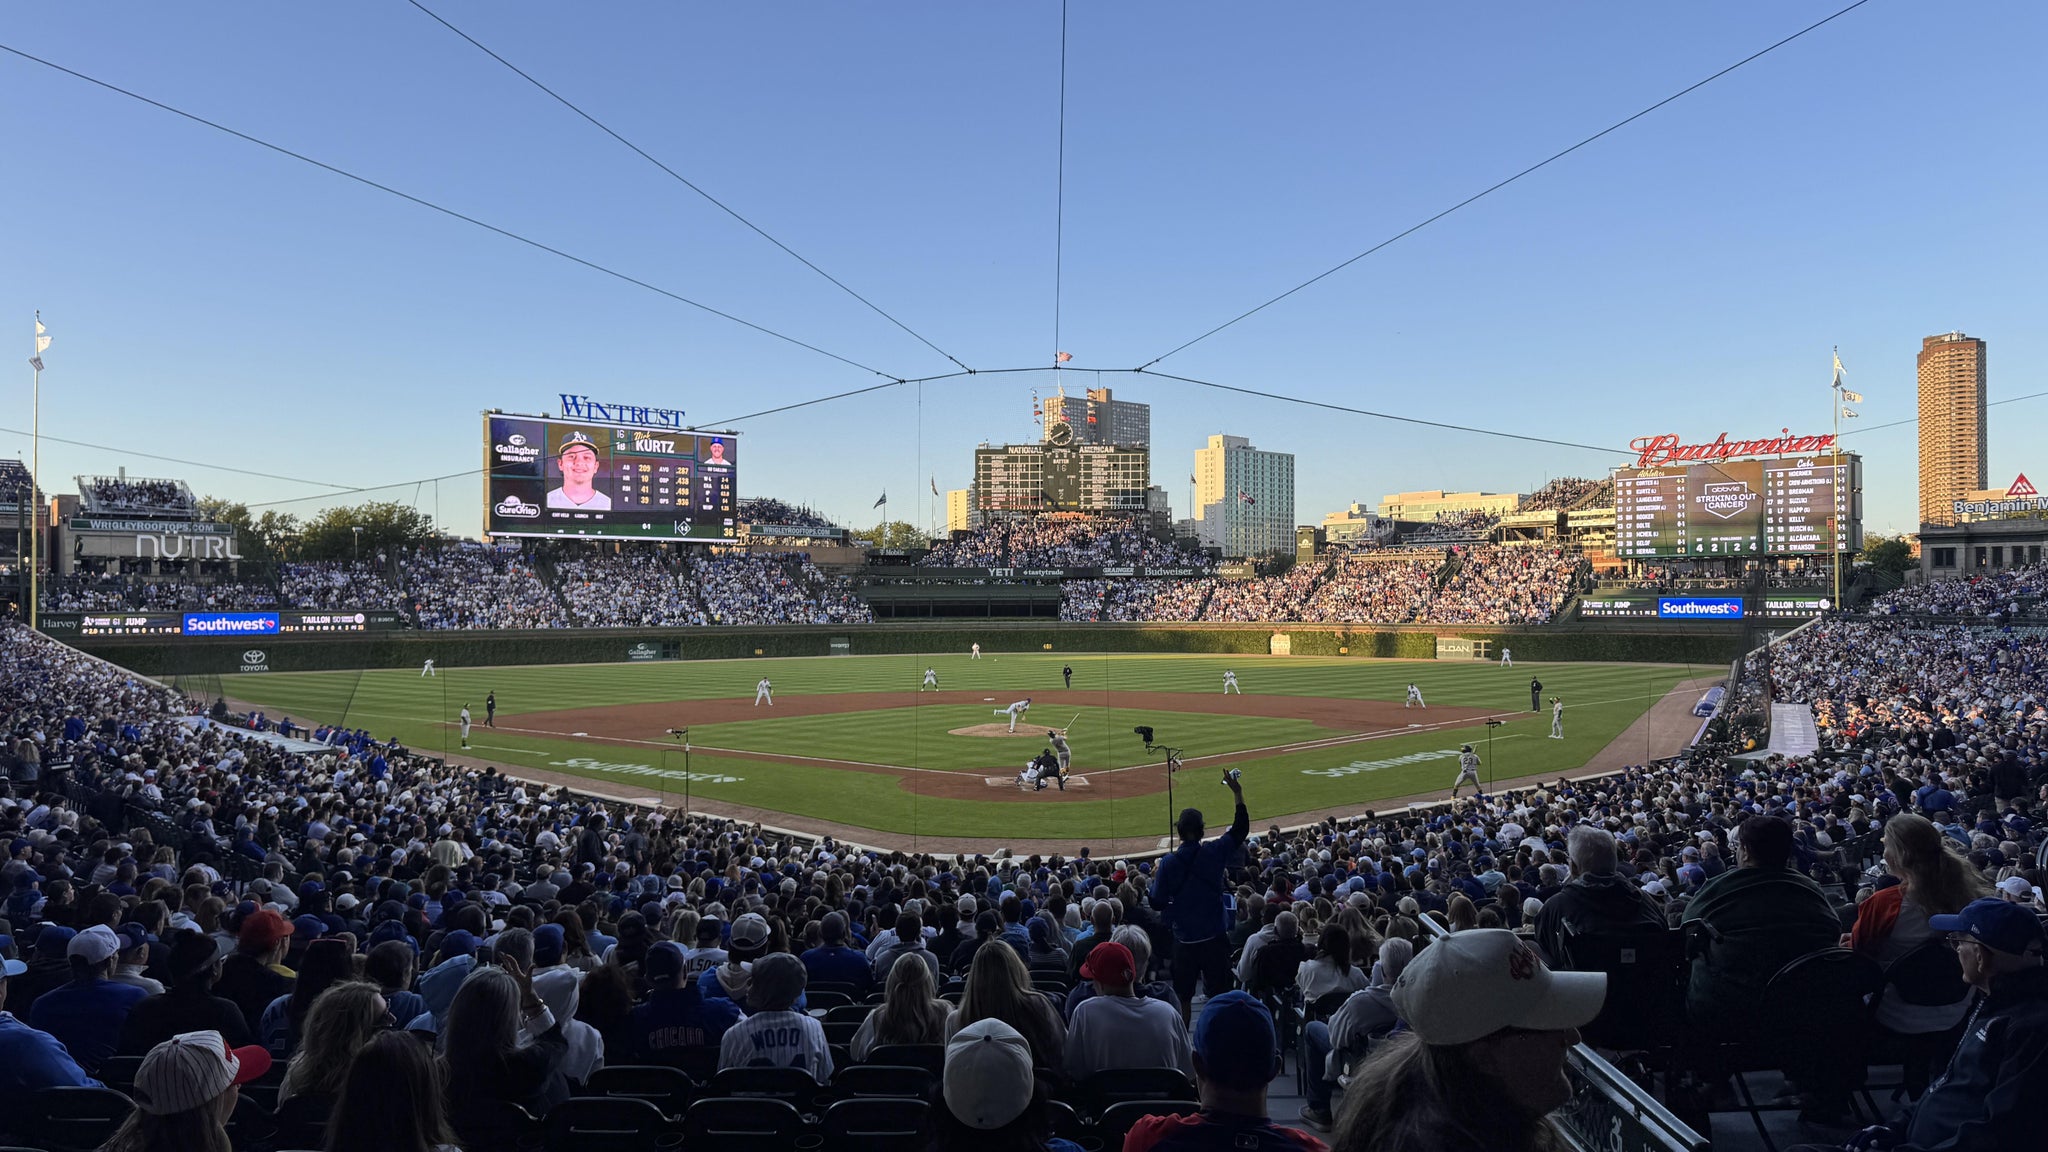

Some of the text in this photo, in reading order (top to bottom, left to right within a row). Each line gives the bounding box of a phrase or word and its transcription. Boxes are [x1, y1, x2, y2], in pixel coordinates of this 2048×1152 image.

[559, 394, 685, 427] WINTRUST
[495, 444, 540, 456] Gallagher
[636, 440, 675, 454] KURTZ
[1008, 446, 1043, 454] NATIONAL
[1079, 446, 1114, 454] AMERICAN
[1629, 427, 1836, 468] Budweiser
[500, 455, 535, 463] INSURANCE
[1796, 459, 1815, 468] Cubs
[1695, 493, 1757, 503] STRIKING OUT
[1708, 500, 1744, 509] CANCER
[1953, 498, 2031, 516] Benjamin
[90, 519, 214, 533] WRIGLEYROOFTOPS.COM
[723, 527, 734, 537] 36
[1695, 542, 1757, 552] 4 2 2 4
[988, 567, 1014, 577] YETI
[1028, 569, 1064, 577] tastytrade
[1144, 567, 1194, 576] Budweiser
[1613, 601, 1631, 609] JUMP
[1662, 601, 1730, 614] Southwest
[1765, 601, 1794, 609] TAILLON
[1795, 601, 1805, 609] 50
[42, 618, 78, 630] Harvey
[125, 617, 147, 626] JUMP
[187, 617, 266, 631] Southwest
[301, 615, 331, 624] TAILLON
[1301, 751, 1446, 778] Southwest
[1463, 757, 1474, 765] 23
[549, 757, 724, 783] Southwest
[750, 1027, 801, 1051] WOOD
